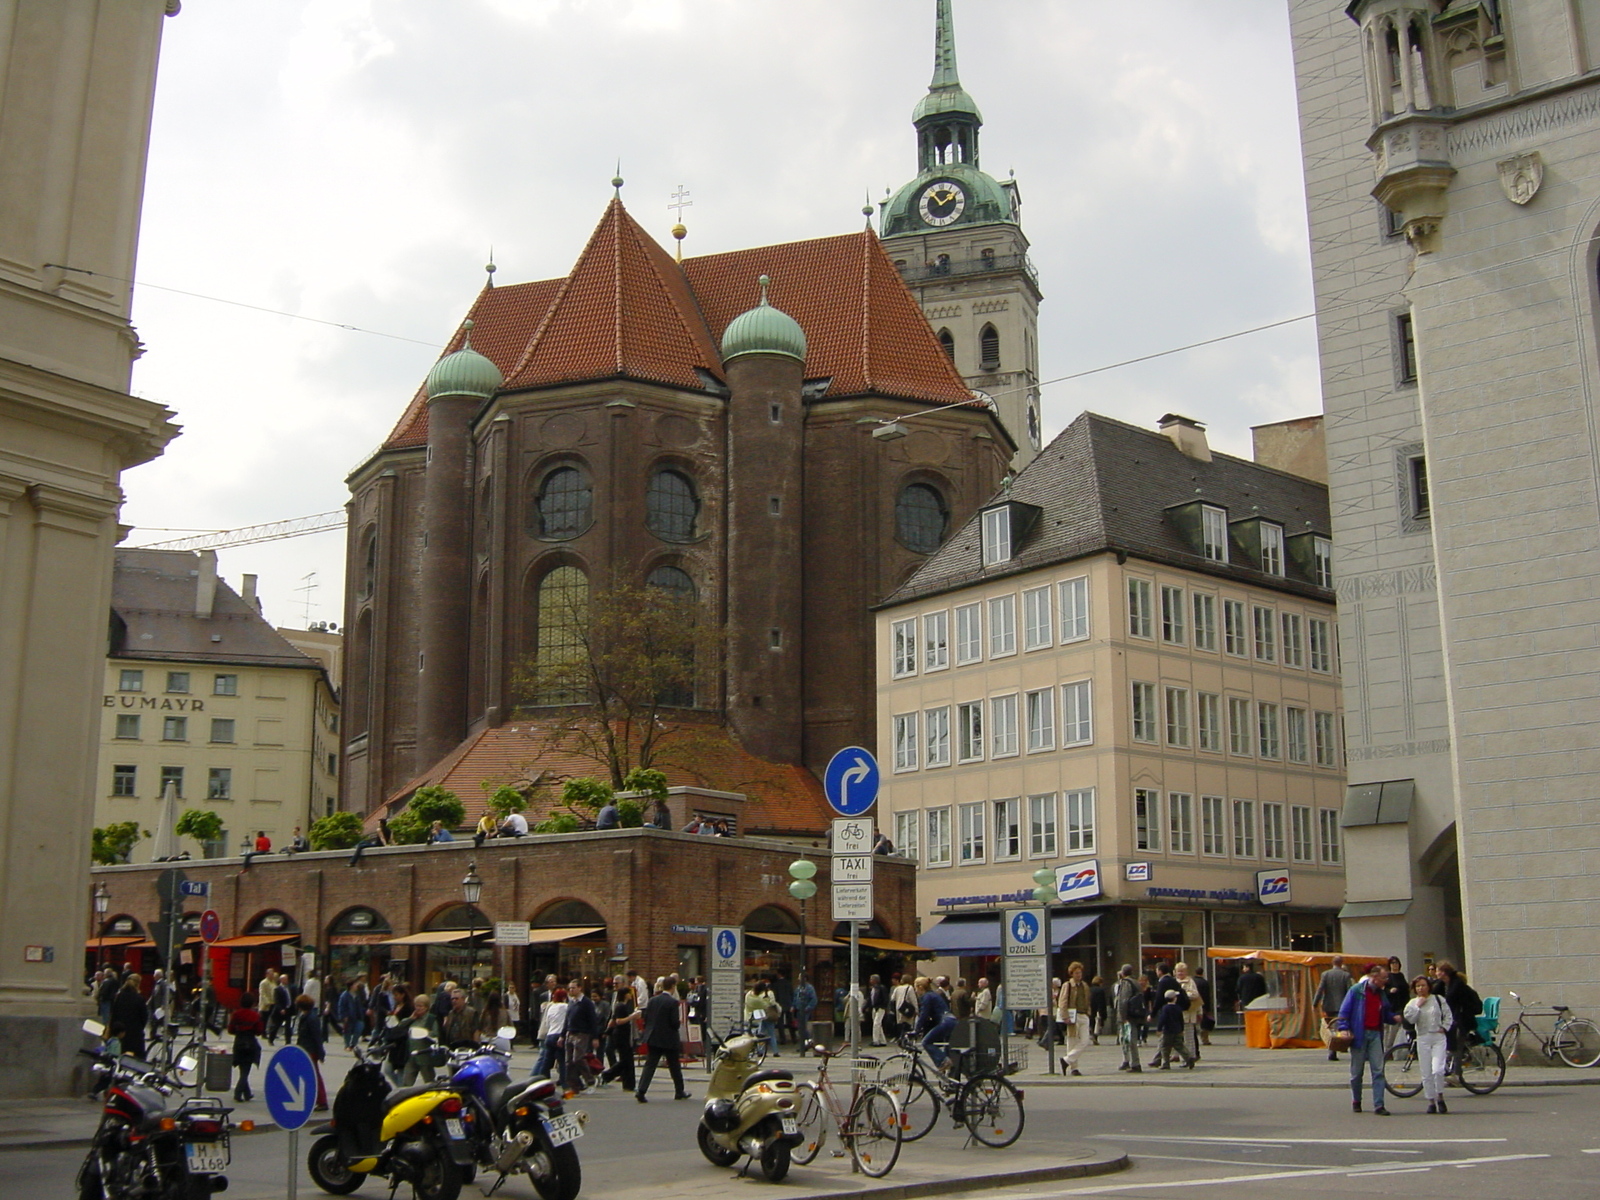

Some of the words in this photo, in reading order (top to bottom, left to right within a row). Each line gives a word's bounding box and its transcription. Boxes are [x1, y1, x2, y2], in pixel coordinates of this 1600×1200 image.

[846, 842, 859, 850] frei
[840, 858, 865, 870] TAXI
[1059, 869, 1096, 893] D2
[1260, 877, 1289, 896] D2
[1016, 945, 1036, 953] ZONE
[551, 1115, 572, 1131] EBE
[565, 1126, 580, 1139] 72
[197, 1144, 207, 1157] M
